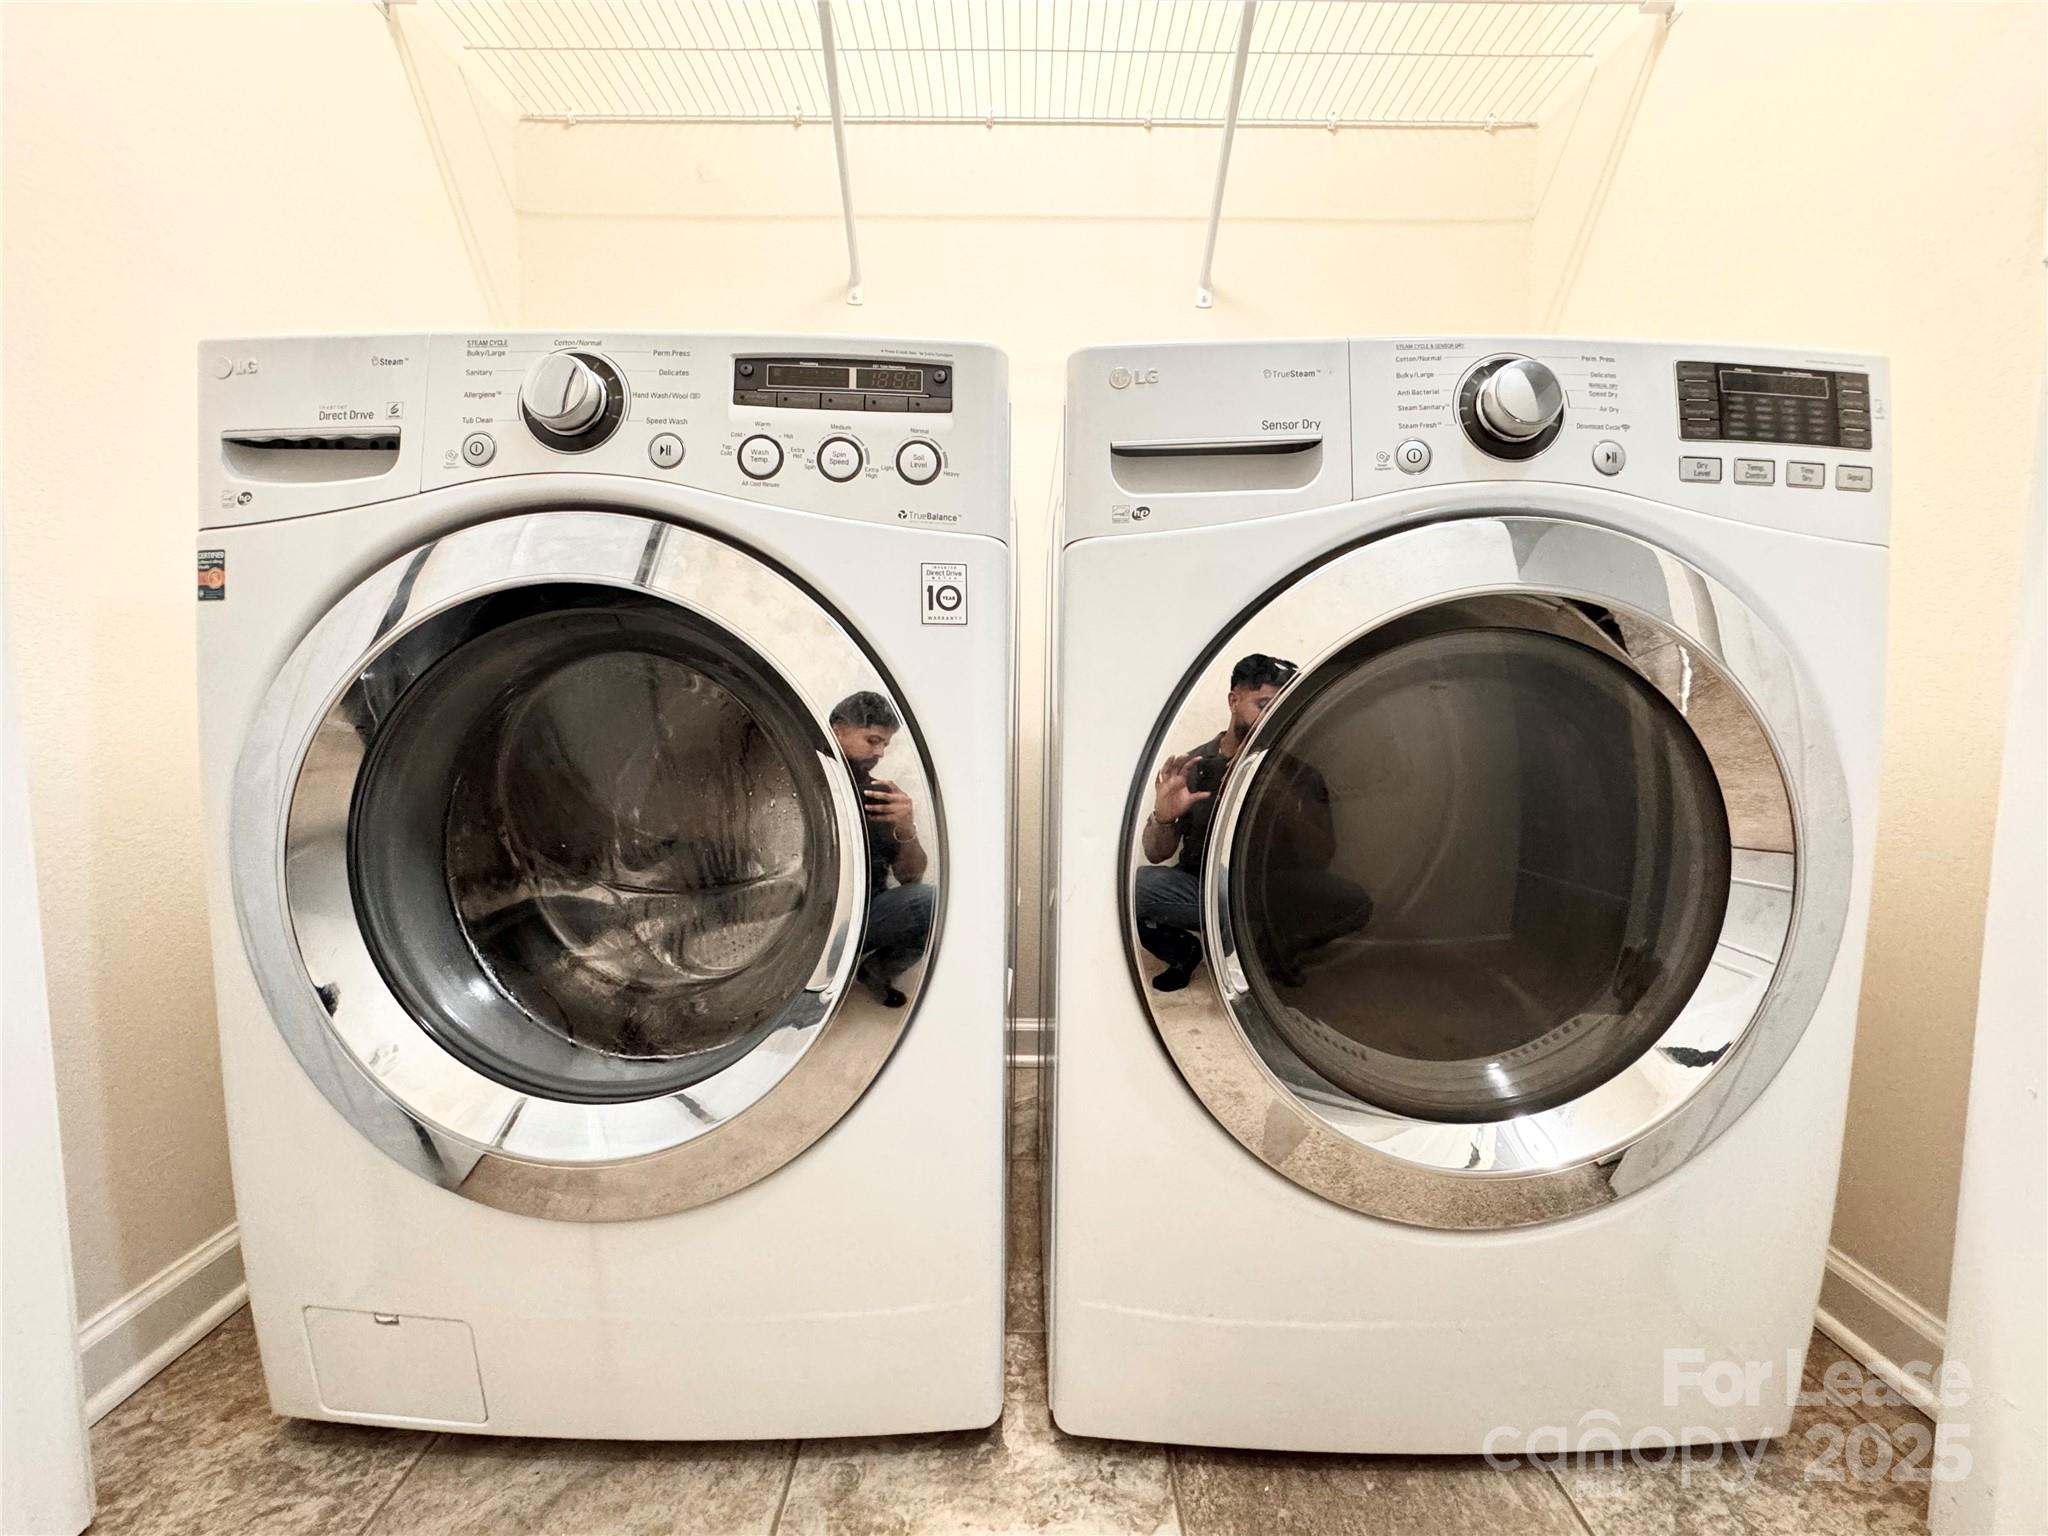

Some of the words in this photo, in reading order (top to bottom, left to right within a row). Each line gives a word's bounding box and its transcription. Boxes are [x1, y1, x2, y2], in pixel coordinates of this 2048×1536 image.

[1134, 369, 1159, 384] LG
[319, 411, 347, 420] Direct
[349, 410, 374, 420] Drive
[646, 417, 667, 425] Speed
[1261, 419, 1300, 431] Sensor
[1302, 418, 1321, 431] Dry
[832, 451, 846, 459] Spin
[750, 456, 768, 464] Temp
[829, 458, 849, 466] Speed
[1696, 462, 1708, 470] Dry
[1693, 469, 1710, 477] Level
[927, 585, 962, 611] 10
